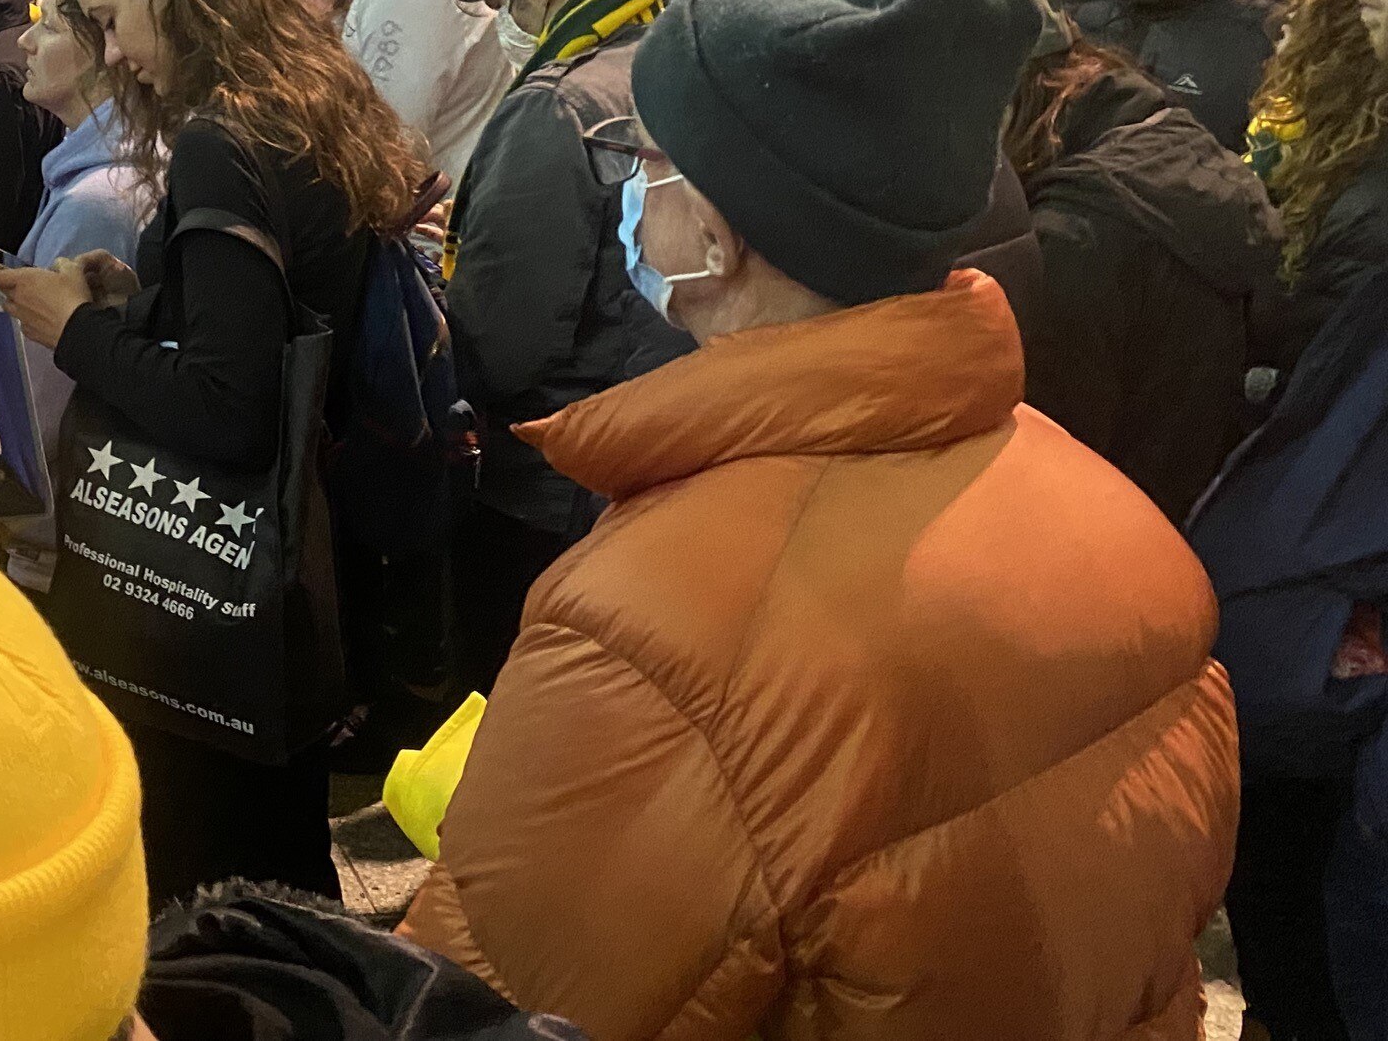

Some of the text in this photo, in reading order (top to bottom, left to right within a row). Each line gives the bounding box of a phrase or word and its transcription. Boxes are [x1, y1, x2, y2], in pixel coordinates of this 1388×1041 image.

[69, 477, 189, 540] ALSEASONS
[64, 533, 141, 578] Professional
[143, 567, 220, 610] Hospitality
[103, 574, 195, 621] 02 9324 4666
[72, 659, 255, 735] w.alseasons.com.au
